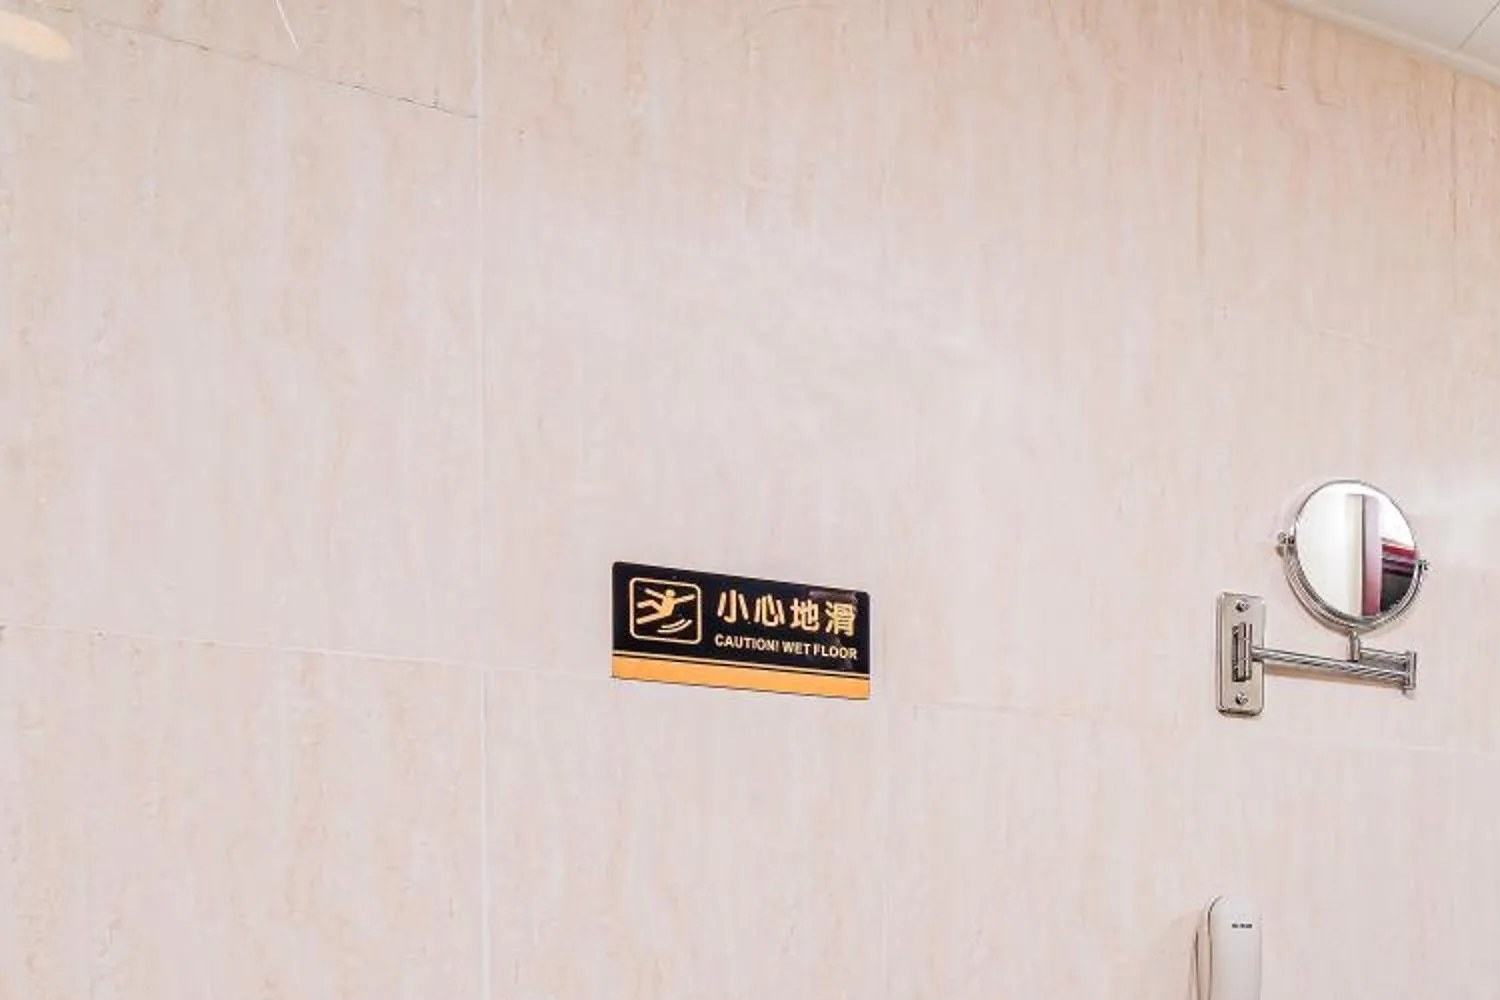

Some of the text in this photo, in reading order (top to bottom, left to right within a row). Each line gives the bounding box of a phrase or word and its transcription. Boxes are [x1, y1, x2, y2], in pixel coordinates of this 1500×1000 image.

[716, 589, 855, 637] 小心地滑
[714, 633, 858, 661] CAUTION! WET FLOOR
